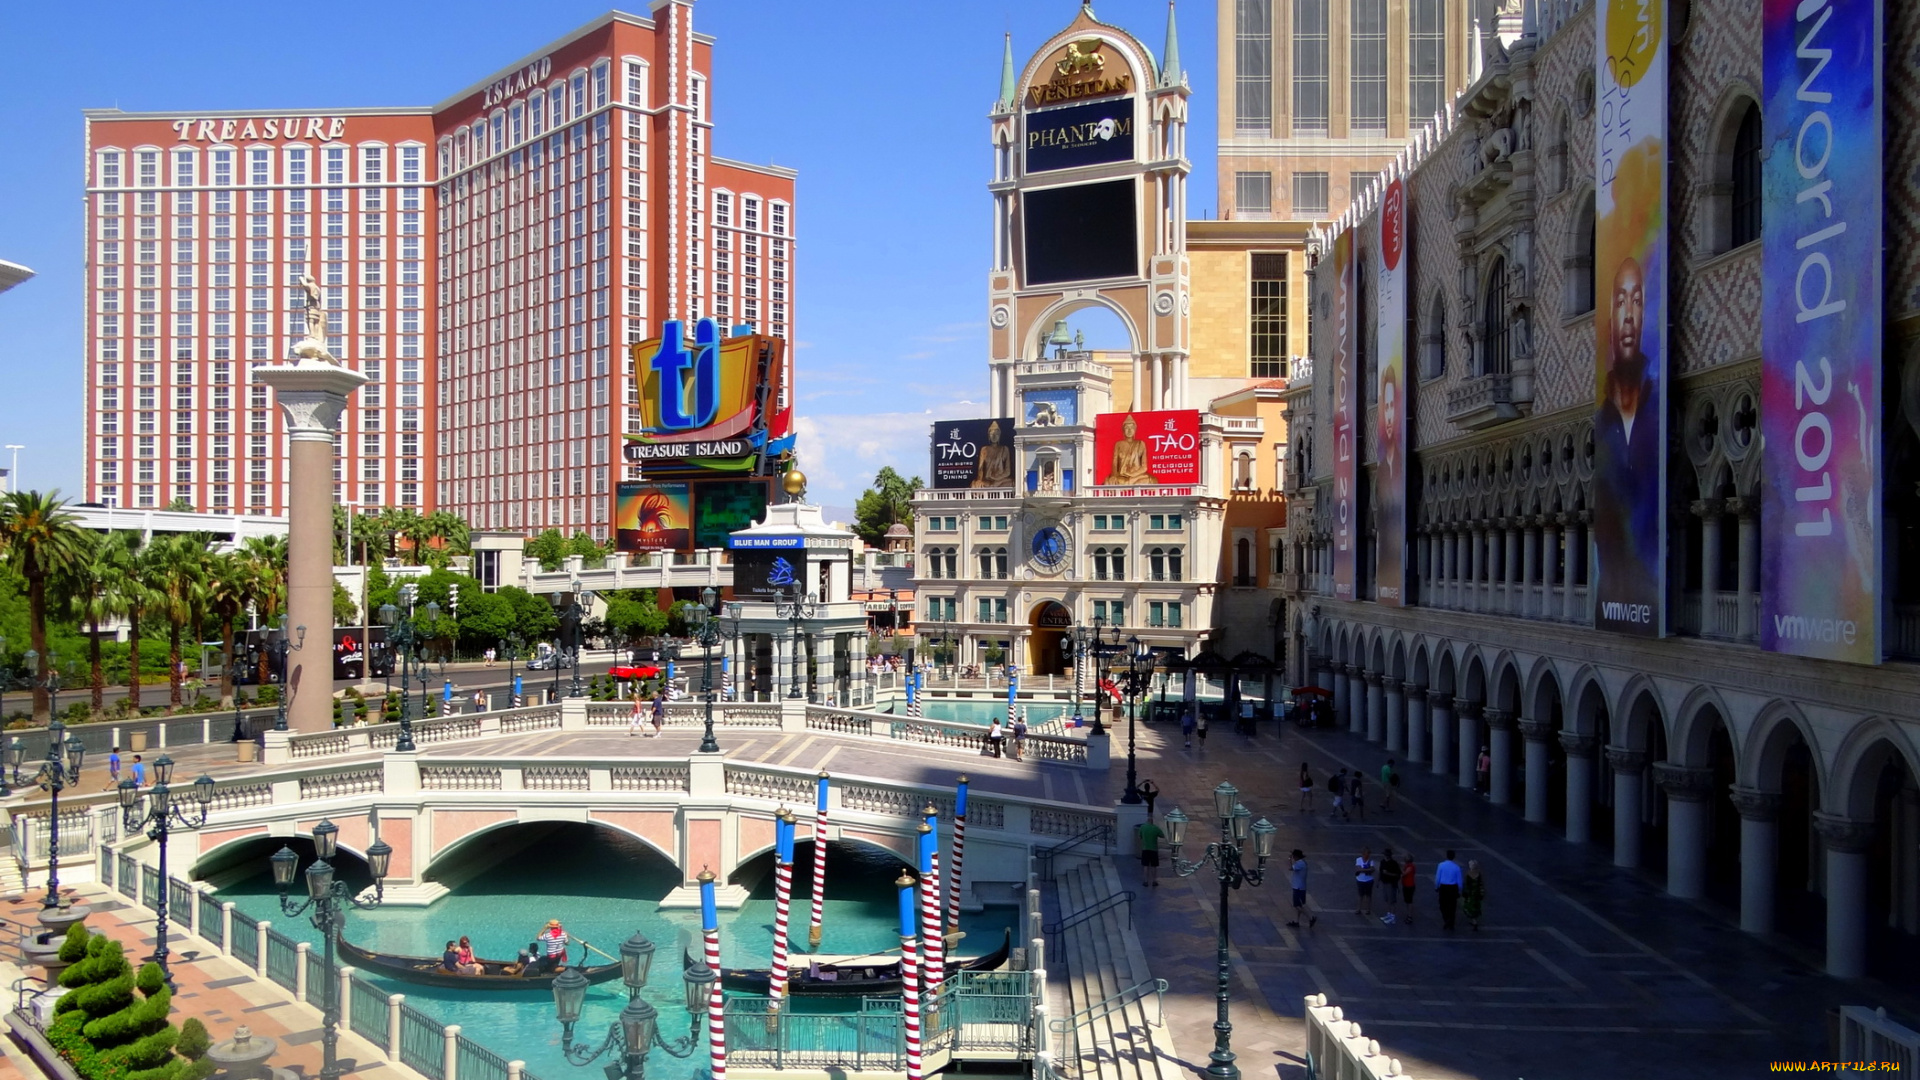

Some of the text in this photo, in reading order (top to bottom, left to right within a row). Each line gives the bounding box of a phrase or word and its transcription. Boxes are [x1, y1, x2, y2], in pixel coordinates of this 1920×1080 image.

[482, 56, 552, 110] ISLAND
[1028, 75, 1130, 105] VENETIAN
[1619, 35, 1636, 143] Your
[172, 117, 346, 143] TREASURE
[1795, 0, 1847, 536] world 2011
[1339, 264, 1349, 551] vmworld 2011
[631, 441, 742, 458] TREASURE ISLAND
[936, 442, 976, 460] TAO
[1148, 433, 1195, 453] TAO
[734, 539, 752, 547] BLUE
[1602, 601, 1650, 624] vmware
[1774, 613, 1857, 645] vmware
